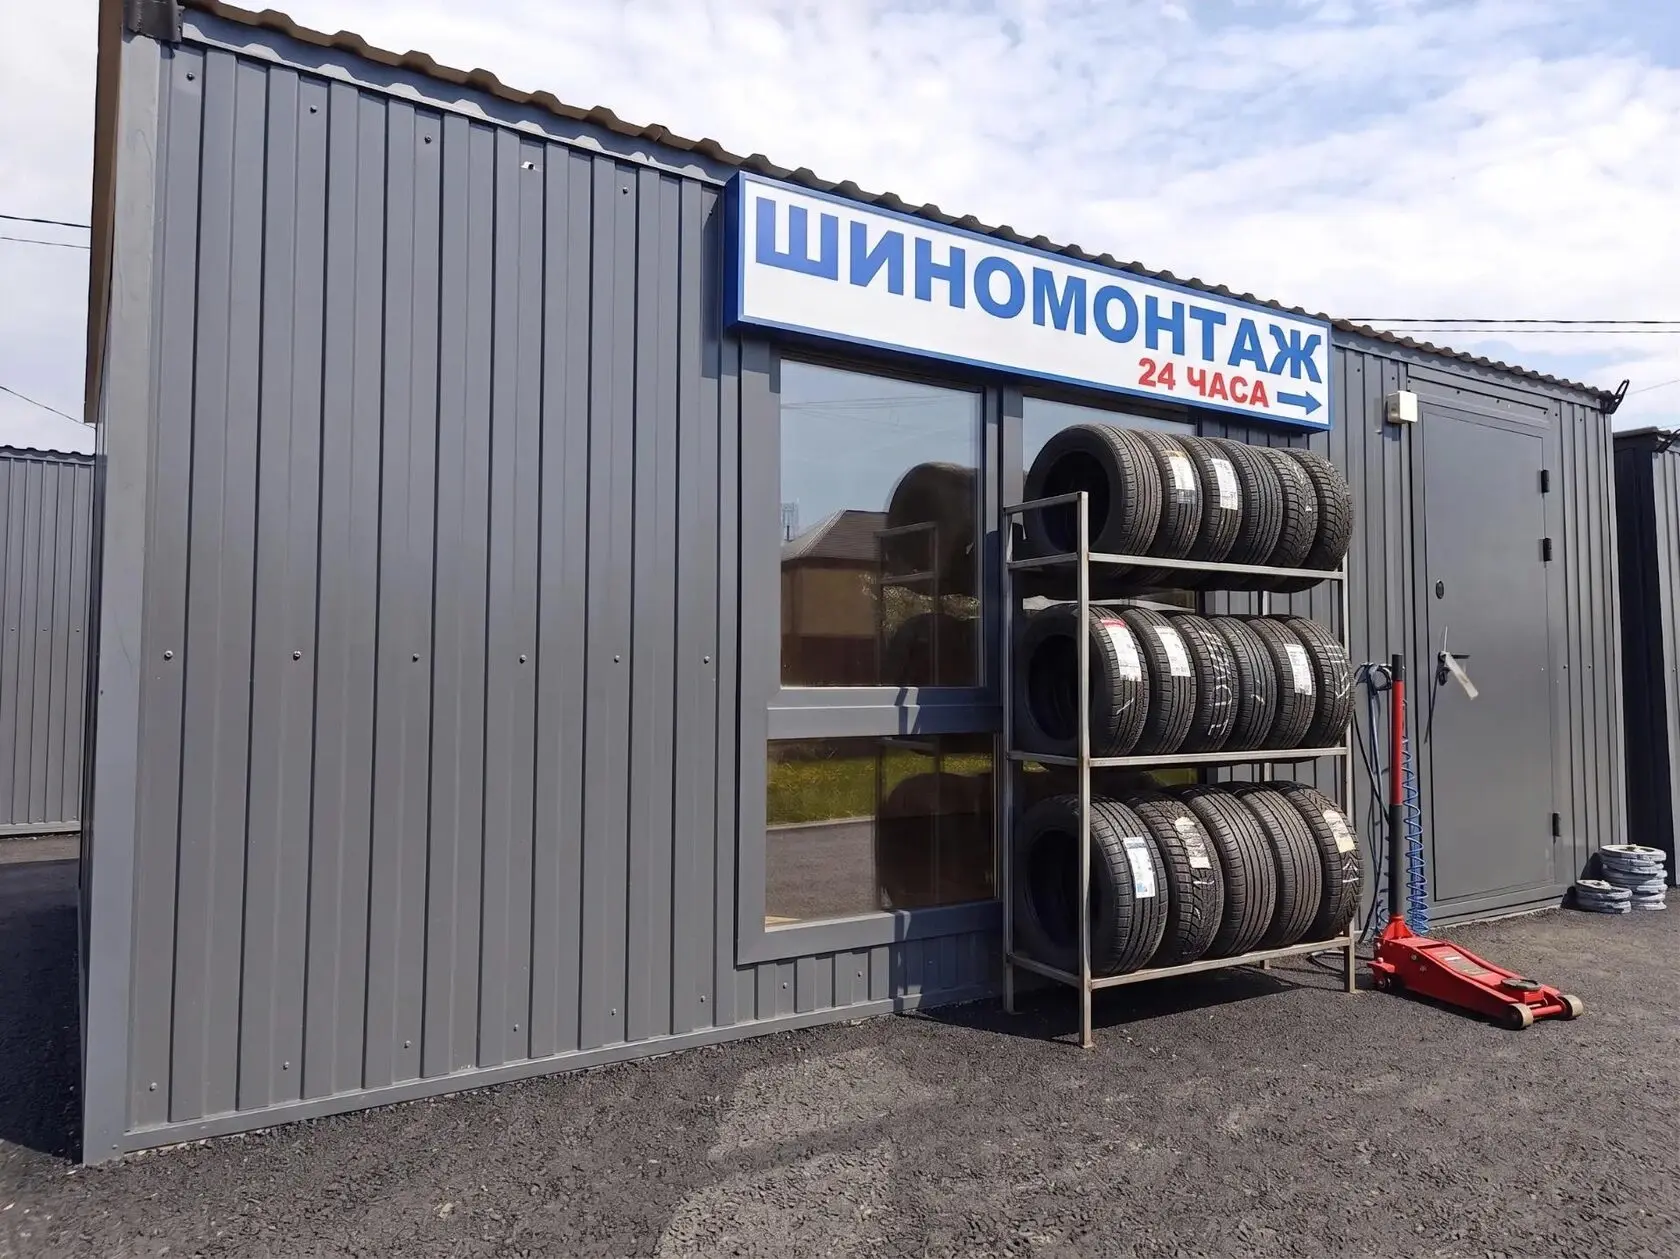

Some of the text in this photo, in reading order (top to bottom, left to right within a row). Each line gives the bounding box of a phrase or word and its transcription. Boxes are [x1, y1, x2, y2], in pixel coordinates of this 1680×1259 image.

[755, 197, 1322, 383] ШИНОМОНТАЖ
[1138, 358, 1270, 407] 24 ЧАСА
